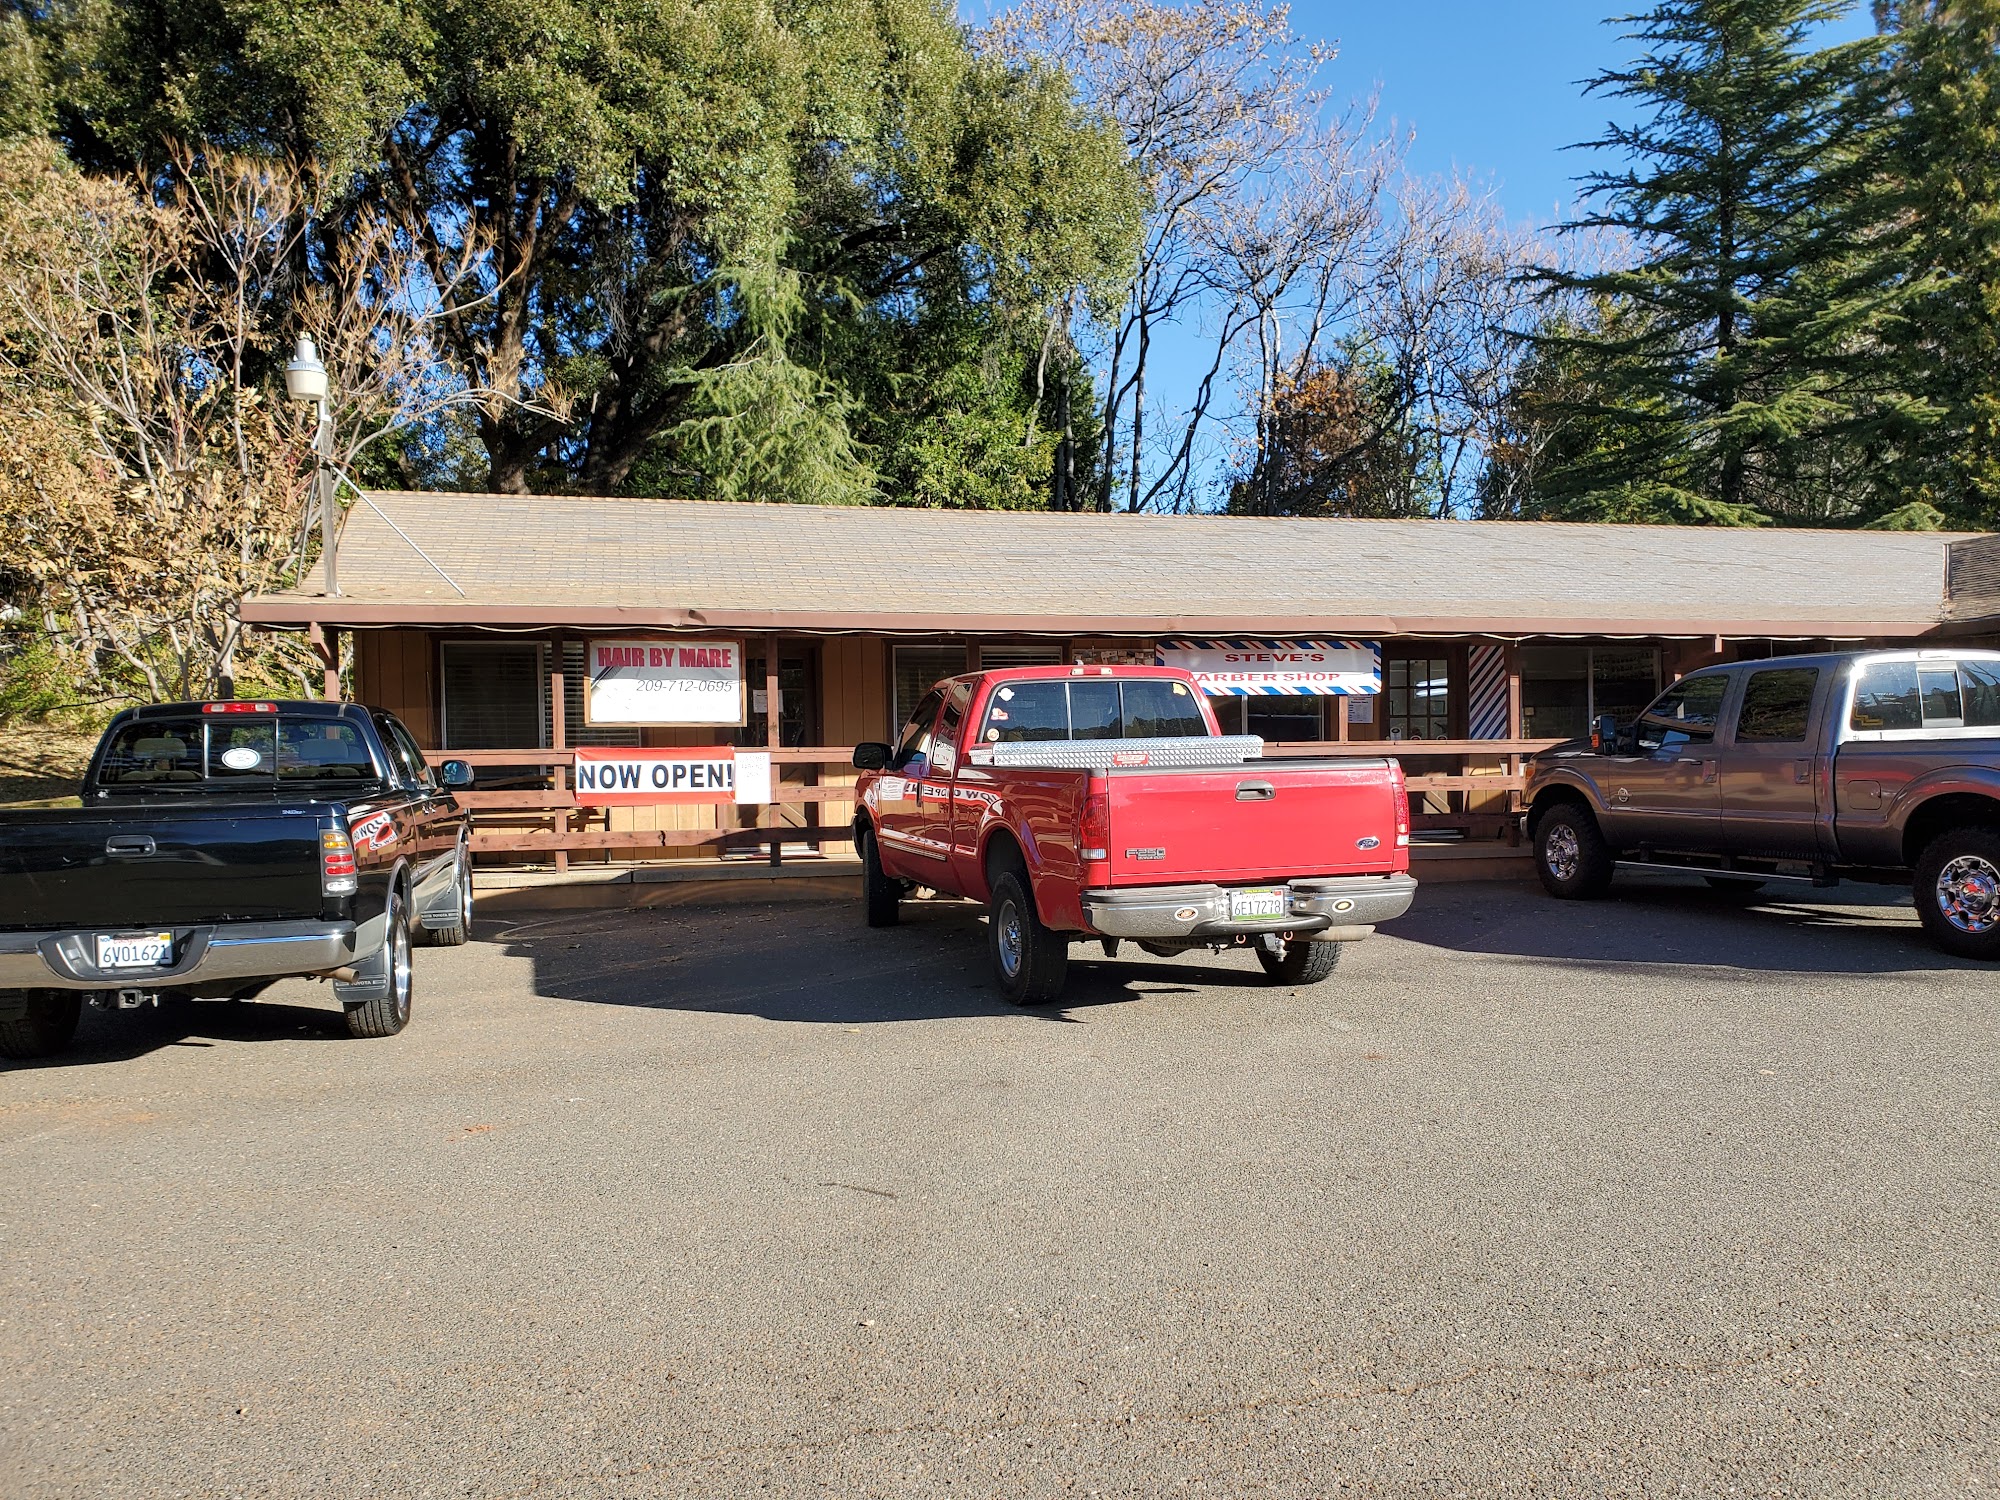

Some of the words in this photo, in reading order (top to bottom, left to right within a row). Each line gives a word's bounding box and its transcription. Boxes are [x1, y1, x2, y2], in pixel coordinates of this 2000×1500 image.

[597, 647, 645, 667] HAIR
[649, 648, 675, 667] BY
[679, 648, 732, 668] MARE
[1225, 653, 1325, 662] STEVE'S
[1197, 672, 1281, 682] ARBER
[1284, 672, 1341, 681] SHOP
[637, 680, 733, 692] 209-712-0695
[579, 764, 642, 789] NOW
[652, 764, 733, 788] OPEN!
[1234, 899, 1281, 916] 6E17278
[103, 944, 169, 963] 6V01621
